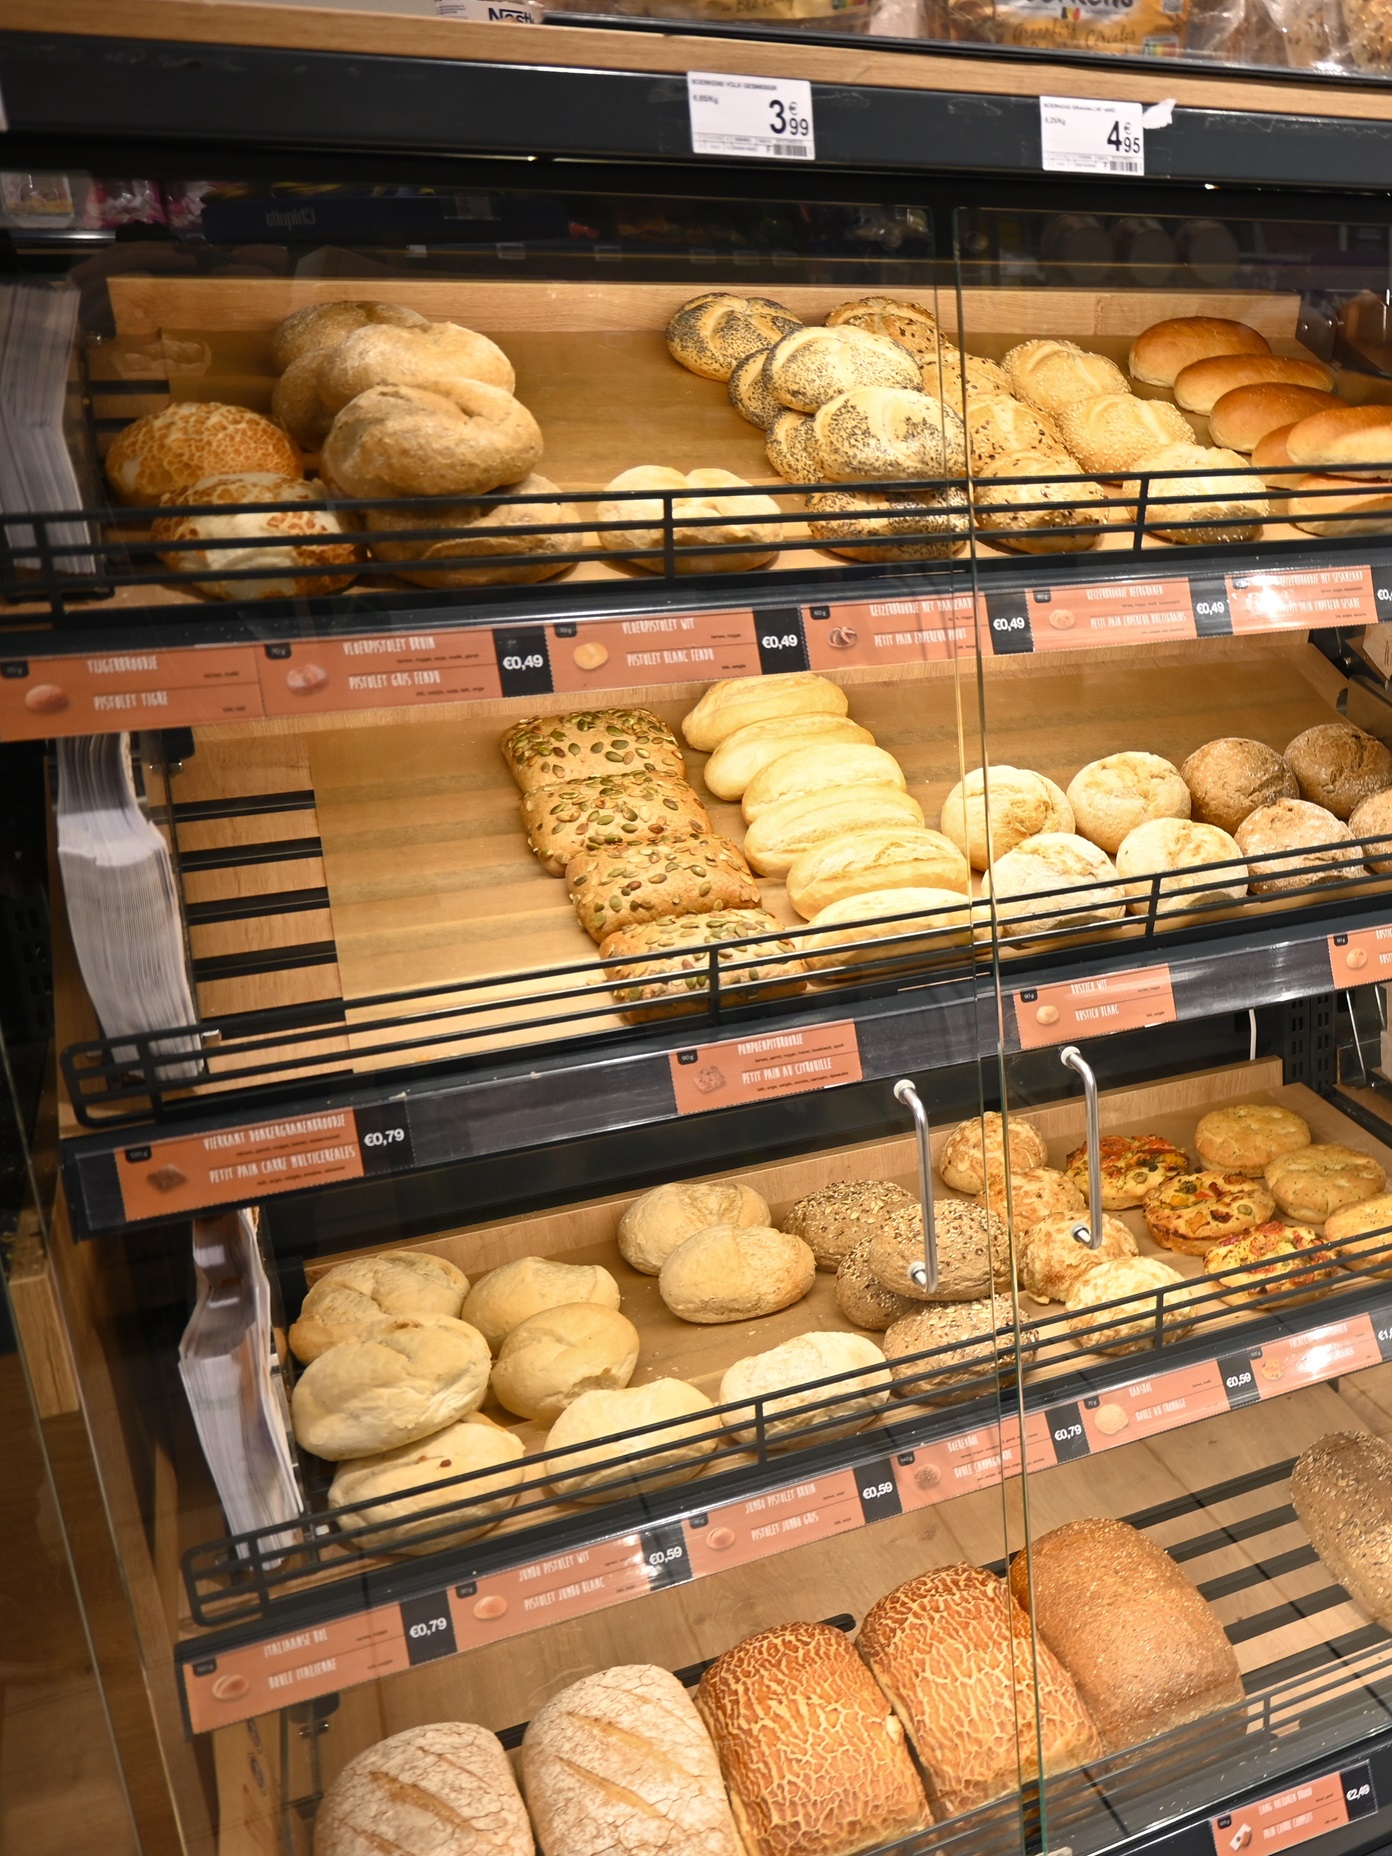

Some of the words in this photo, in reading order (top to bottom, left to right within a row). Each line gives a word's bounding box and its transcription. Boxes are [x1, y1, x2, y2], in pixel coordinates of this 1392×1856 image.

[769, 99, 787, 134] 3
[789, 118, 809, 136] 99
[1107, 120, 1122, 151] 4
[1123, 137, 1140, 153] 95
[1196, 602, 1225, 615] €0,49
[622, 619, 679, 635] VLOERPISTOLET
[681, 618, 695, 630] WIT
[993, 617, 1025, 631] €0,49
[1090, 617, 1106, 629] PETIT
[343, 638, 407, 656] VLOERPISTOLET
[409, 636, 436, 651] BRUIN
[762, 634, 799, 649] €0,49
[874, 634, 894, 648] PETIT
[896, 632, 913, 645] PAIN
[914, 630, 946, 644] EMPEREUR
[503, 654, 544, 671] €0,49
[627, 652, 662, 667] PISTOLET
[664, 650, 687, 664] BLANC
[691, 648, 715, 663] FENDU
[349, 674, 388, 691] PISTOLET
[391, 672, 412, 687] GRIS
[414, 671, 441, 685] FENDU
[94, 693, 137, 711] PISTOLET
[140, 691, 169, 707] TIGRE
[1071, 982, 1095, 995] RUSTICO
[1096, 979, 1108, 991] WIT
[1075, 1009, 1099, 1022] RUSTICO
[1101, 1004, 1119, 1017] BLANC
[738, 1033, 803, 1056] POMPOENPITBROODJE
[742, 1071, 761, 1085] PETIT
[764, 1069, 781, 1082] PAIN
[782, 1066, 793, 1077] AU
[795, 1058, 832, 1075] CITROUILLE
[203, 1132, 245, 1151] VIERKANT
[364, 1128, 405, 1148] €0,79
[209, 1166, 234, 1184] PETIT
[237, 1161, 259, 1180] PAIN
[1226, 1372, 1252, 1388] €0,59
[1054, 1424, 1082, 1441] €0,79
[745, 1498, 766, 1514] JUMBO
[767, 1490, 795, 1507] PISTOLET
[796, 1483, 817, 1498] BRUIN
[862, 1482, 894, 1500] €0,59
[751, 1525, 780, 1542] PISTOLET
[782, 1516, 802, 1532] JUMBO
[803, 1511, 819, 1526] GRIS
[649, 1546, 683, 1566] €0,59
[518, 1565, 542, 1582] JUMBO
[544, 1556, 575, 1573] PISTOLET
[576, 1551, 590, 1564] WIT
[523, 1593, 557, 1612] PISTOLET
[558, 1585, 581, 1601] JUMBO
[582, 1577, 606, 1594] BLANC
[409, 1617, 448, 1639] €0,79
[263, 1632, 311, 1658] ITALIAANSE
[313, 1628, 329, 1644] BOL
[267, 1673, 294, 1690] BOULE
[296, 1658, 337, 1682] ITALIENNE
[1346, 1784, 1371, 1801] €2,49
